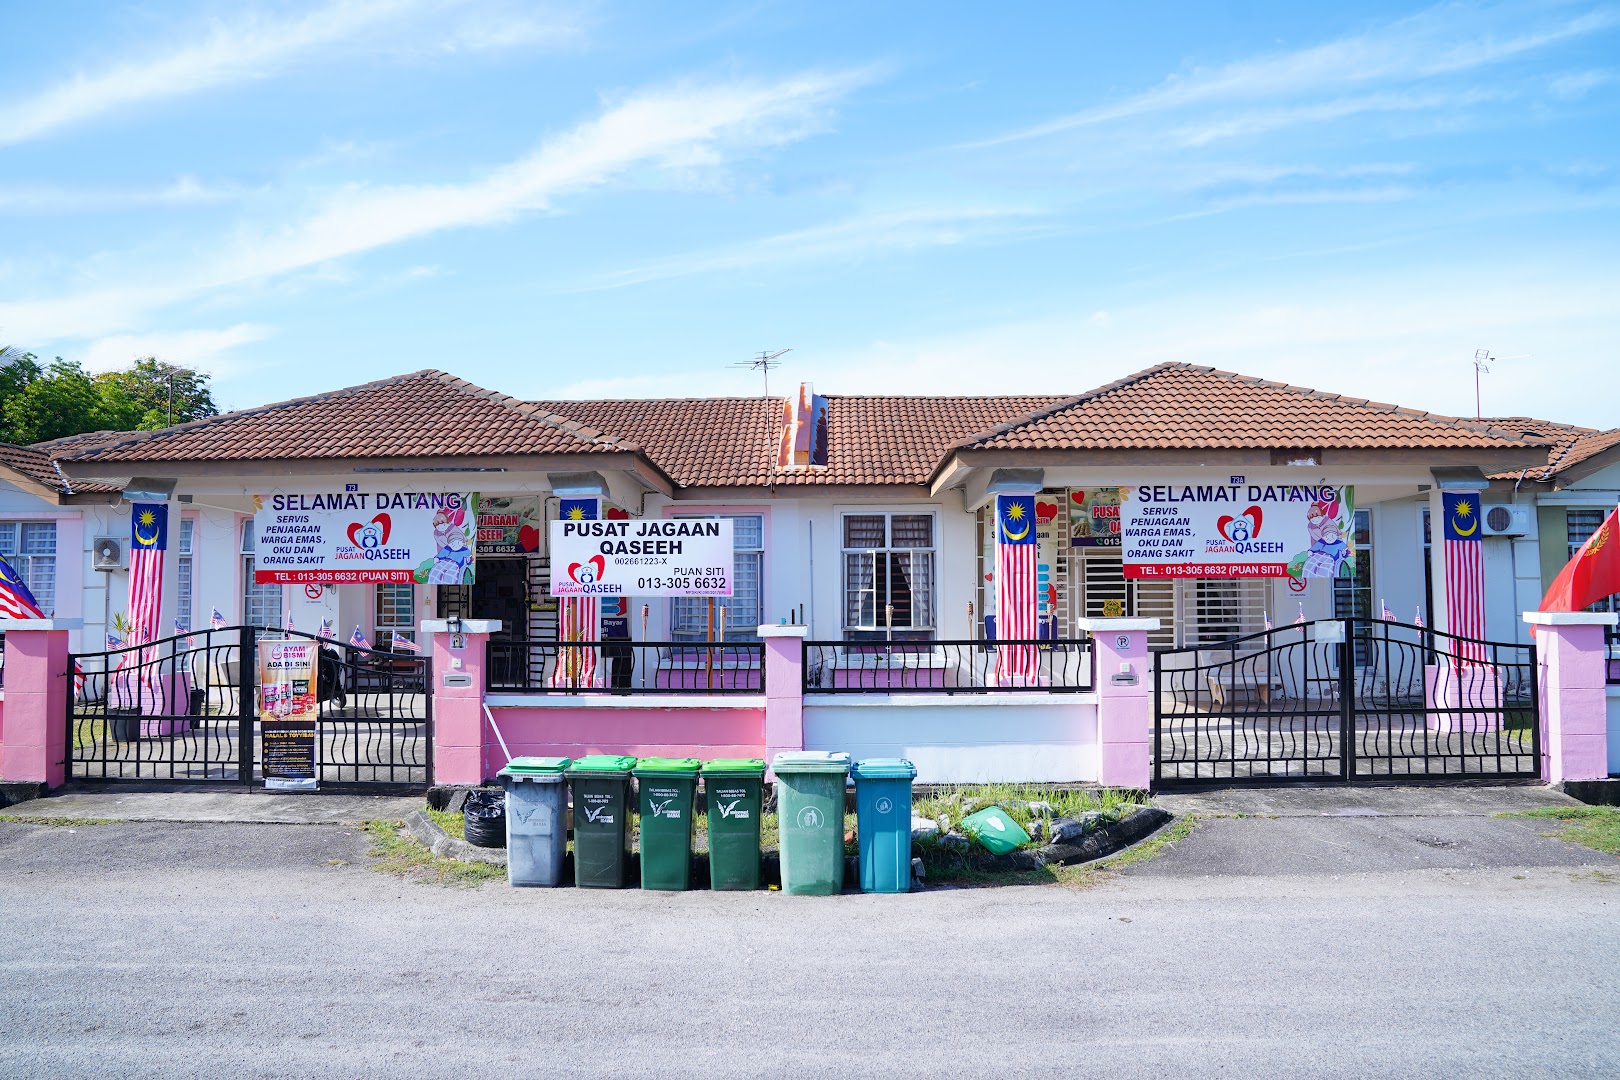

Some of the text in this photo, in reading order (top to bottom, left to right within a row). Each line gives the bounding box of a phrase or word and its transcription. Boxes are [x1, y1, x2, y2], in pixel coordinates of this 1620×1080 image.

[1138, 486, 1335, 502] SELAMAT DATANG
[272, 493, 460, 510] SELAMAT DATANG
[1143, 508, 1178, 516] SERVIS
[482, 515, 518, 526] JAGAAN
[564, 523, 719, 536] PUSAT JAGAAN
[600, 541, 682, 555] QASEEH
[1236, 542, 1283, 554] QASEEH
[365, 549, 410, 560] QASEEH
[1166, 566, 1202, 575] 013-305
[1204, 566, 1226, 575] 6632
[1229, 566, 1258, 575] (PUAN
[1261, 566, 1282, 575] SITI)
[358, 572, 388, 582] (PUAN
[390, 572, 410, 582] SITI)
[638, 578, 726, 588] 013-305 6632
[582, 584, 622, 594] QASEEH
